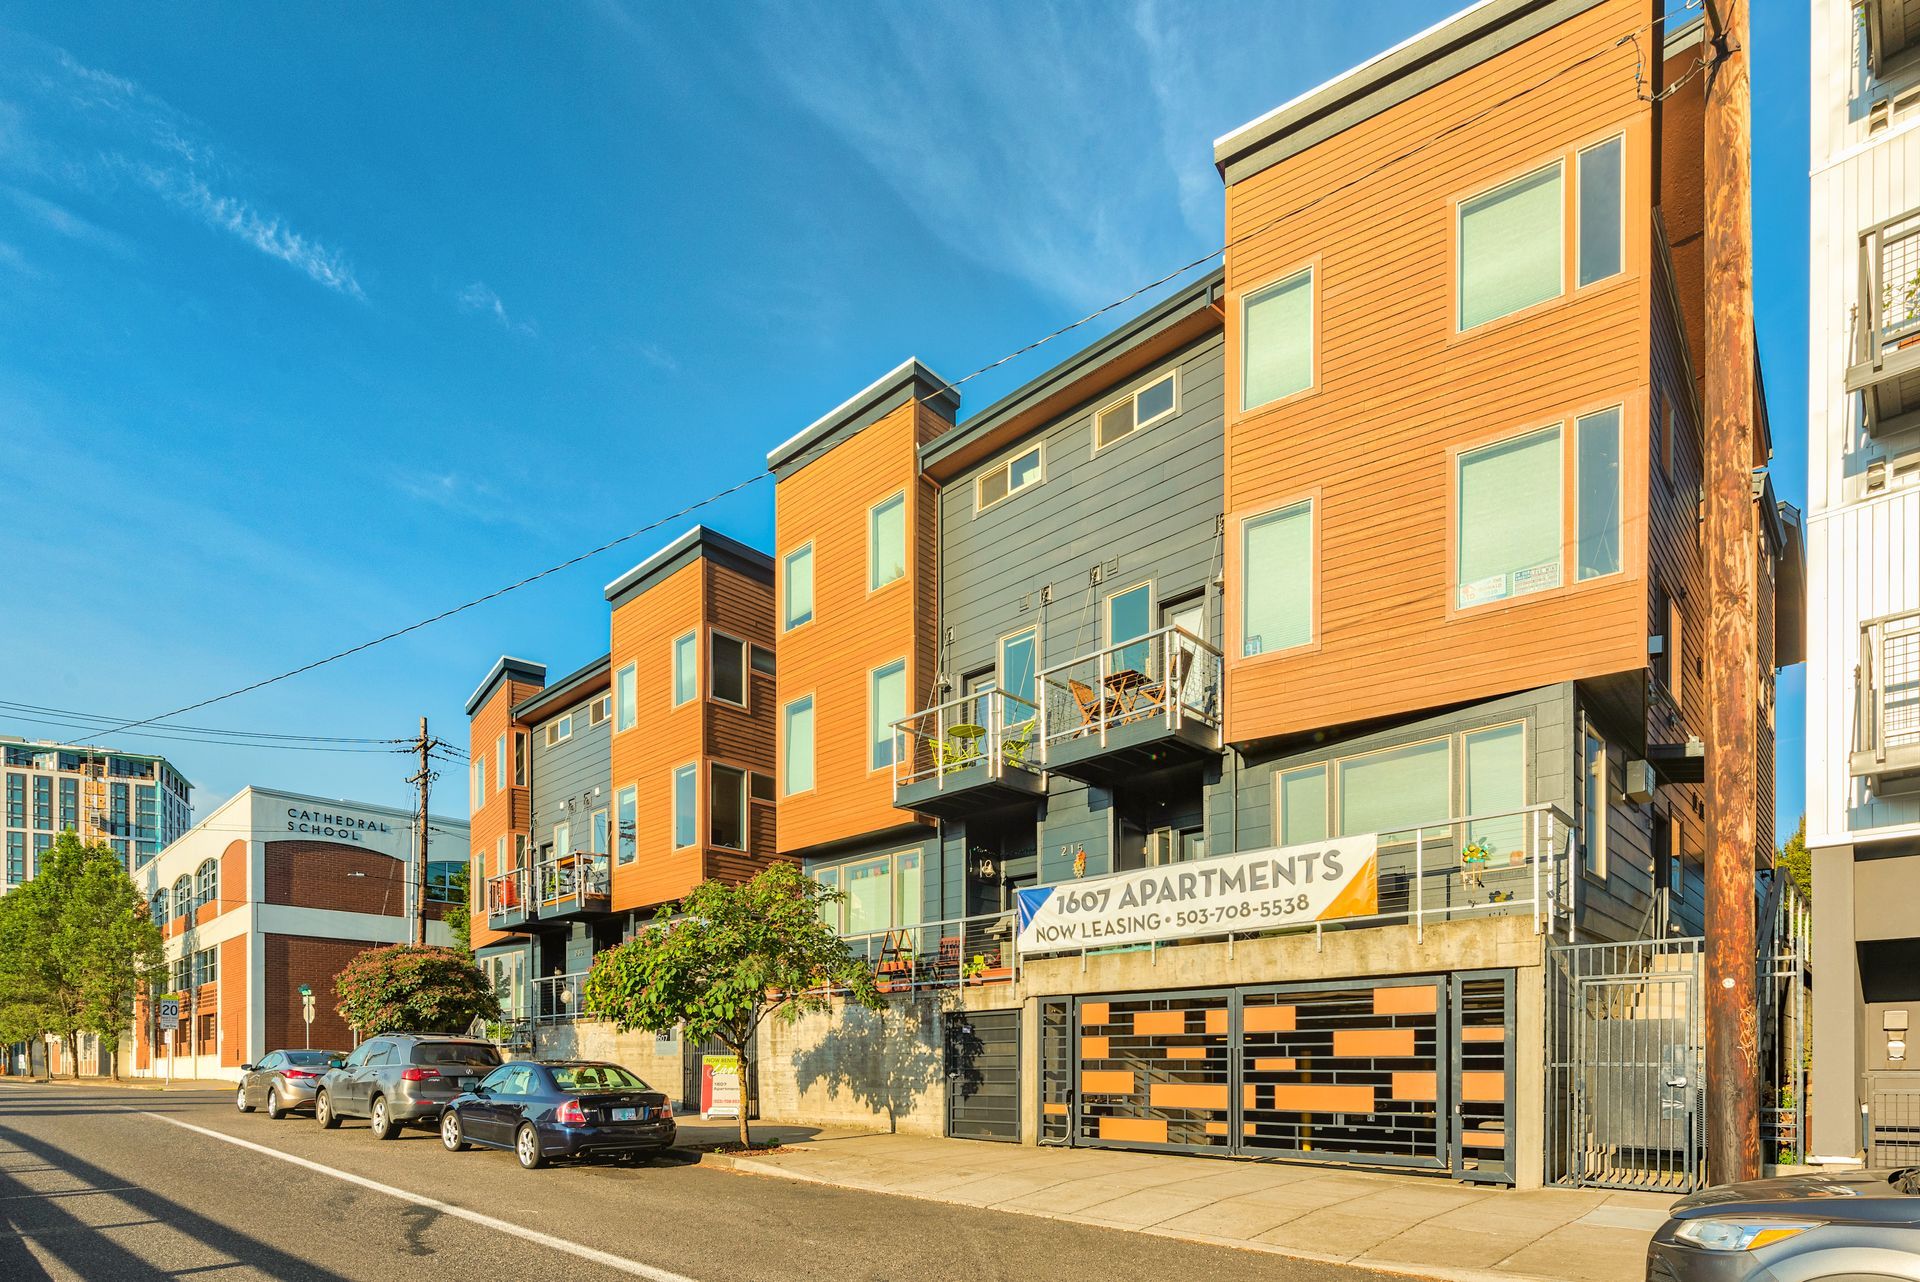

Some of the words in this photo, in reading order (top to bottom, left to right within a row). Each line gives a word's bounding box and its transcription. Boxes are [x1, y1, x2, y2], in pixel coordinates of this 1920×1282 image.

[287, 808, 387, 832] CATHEDRAL
[287, 821, 358, 840] SCHOOL
[1056, 888, 1111, 915] 1607
[1118, 849, 1344, 909] APARTMENTS
[1036, 923, 1077, 943] NOW
[1081, 913, 1161, 938] LEASING
[1176, 893, 1310, 927] 503-708-5538
[162, 1004, 178, 1016] 20
